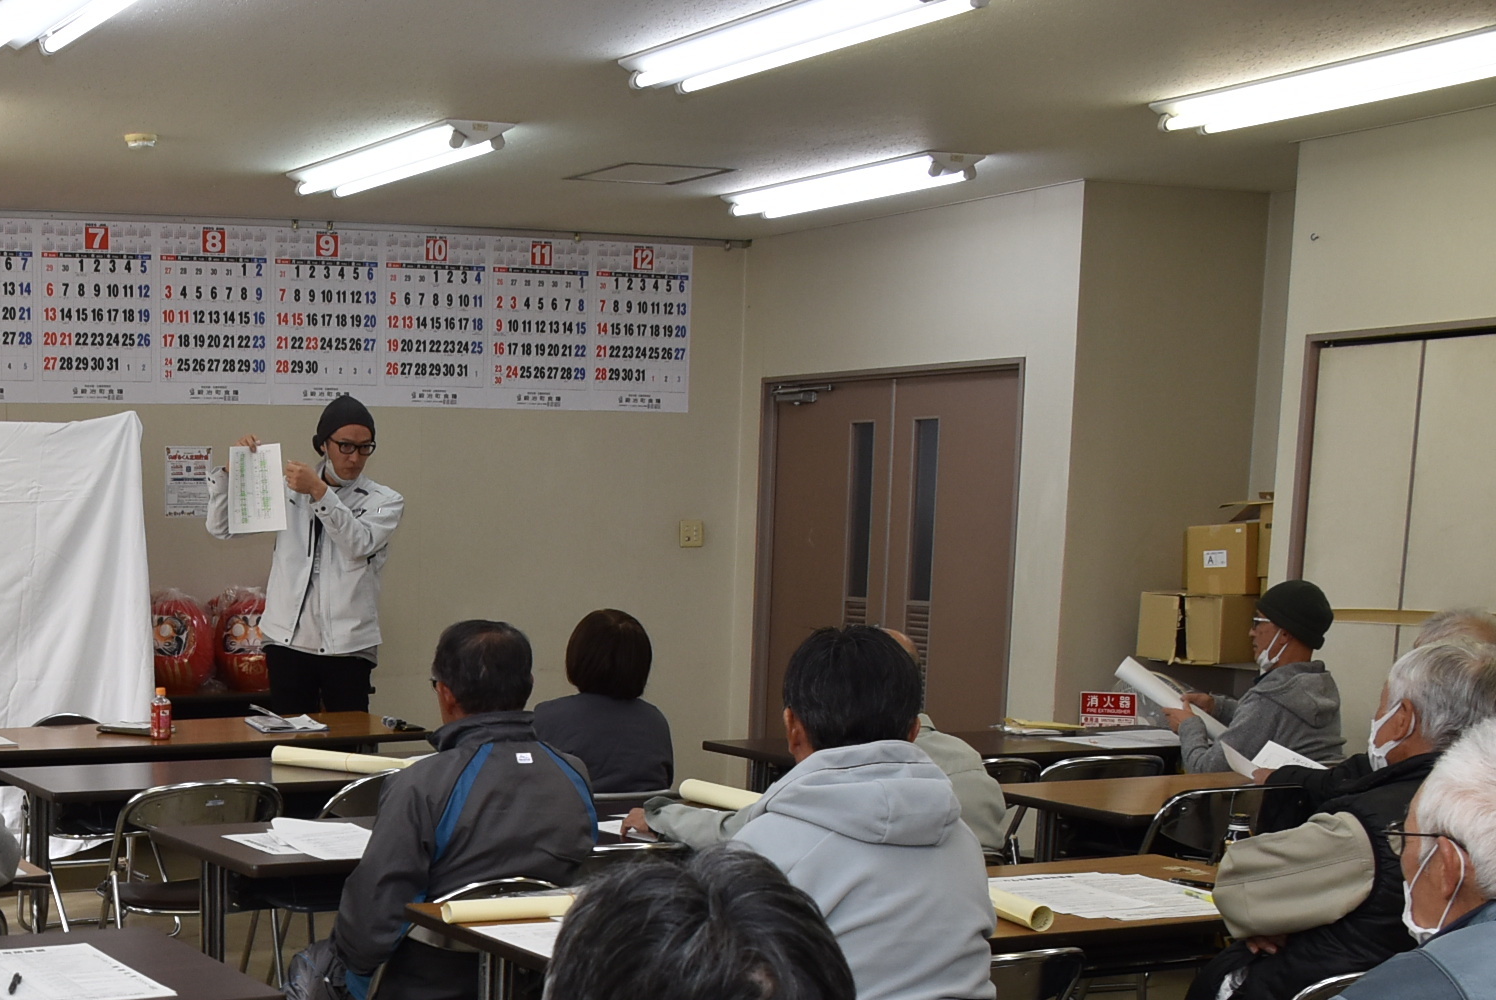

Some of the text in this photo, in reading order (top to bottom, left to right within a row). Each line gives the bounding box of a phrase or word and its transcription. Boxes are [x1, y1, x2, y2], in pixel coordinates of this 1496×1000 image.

[88, 228, 105, 249] 7
[206, 231, 222, 253] 8
[319, 235, 335, 256] 9
[427, 239, 446, 260] 10
[533, 245, 550, 265] 11
[635, 249, 652, 269] 12
[2, 306, 16, 321] 20
[19, 306, 31, 320] 21
[162, 309, 265, 325] 10 11 12 13 14 15 16
[277, 312, 377, 328] 14 15 16 17 18 19 20
[43, 332, 151, 347] 20 21 22 23 24 25 26
[387, 338, 483, 355] 19 20 21 22 23 24 25
[493, 342, 586, 358] 16 17 18 19 20 21 22
[596, 345, 686, 360] 21 22 23 24 25 26 27
[1207, 556, 1214, 564] A
[1086, 695, 1131, 709] 消火器
